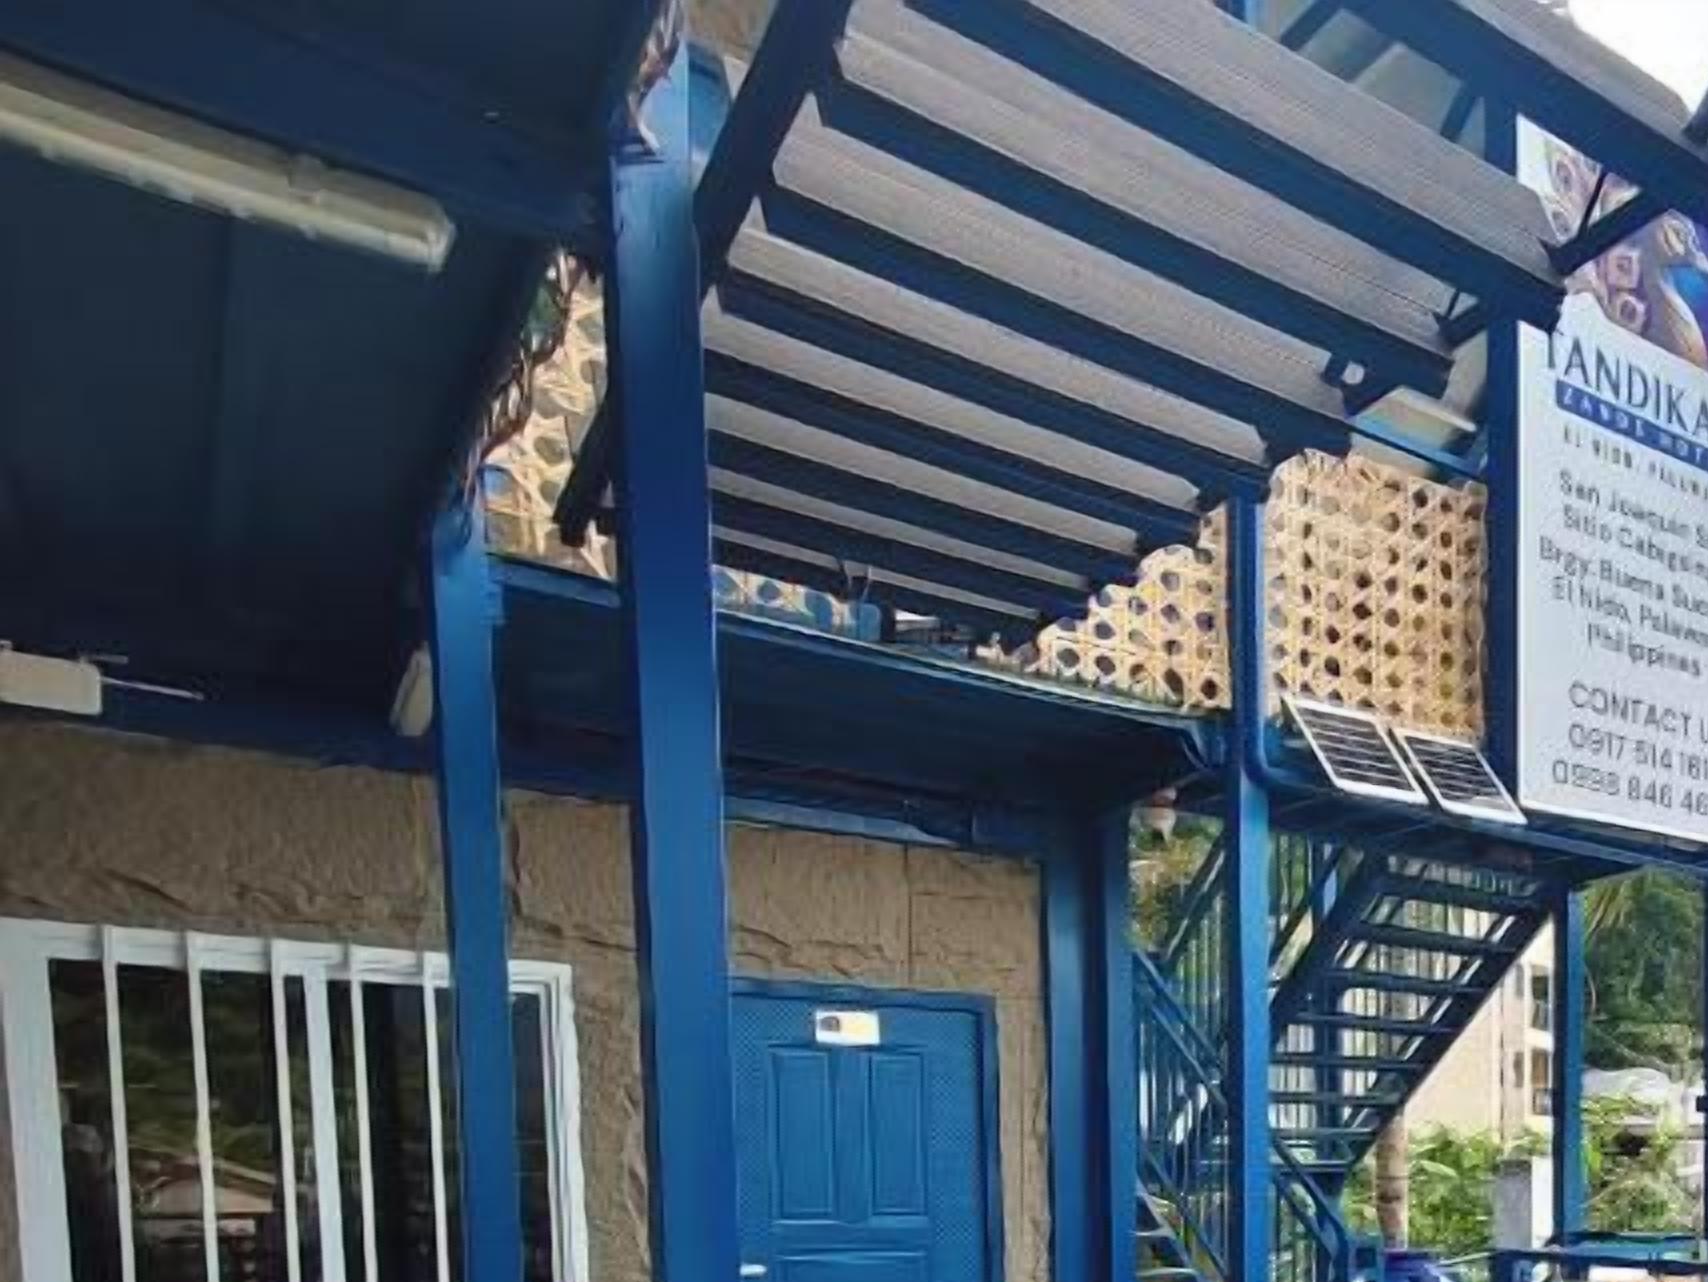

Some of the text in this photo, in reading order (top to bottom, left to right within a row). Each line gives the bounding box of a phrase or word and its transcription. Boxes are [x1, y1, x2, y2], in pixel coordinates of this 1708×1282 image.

[1560, 470, 1600, 506] San
[1569, 680, 1692, 737] CONTACT
[1569, 723, 1626, 761] 0917
